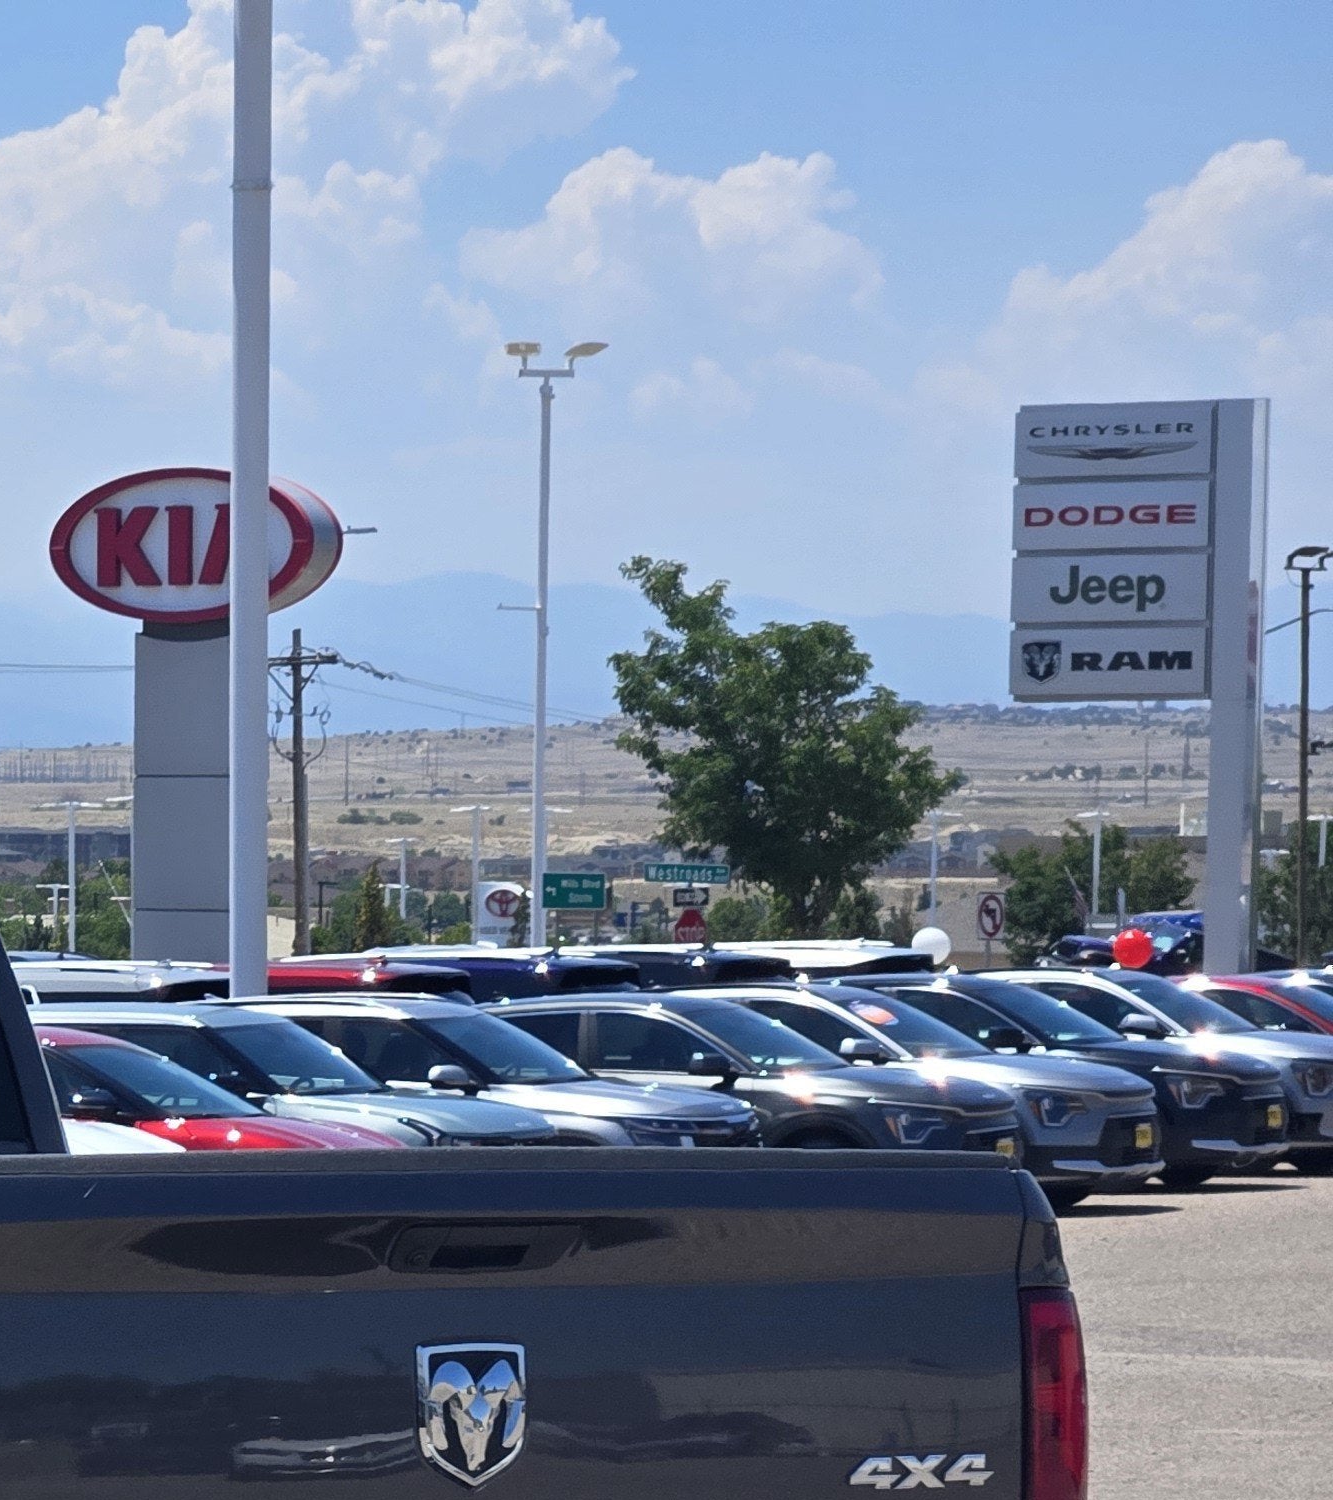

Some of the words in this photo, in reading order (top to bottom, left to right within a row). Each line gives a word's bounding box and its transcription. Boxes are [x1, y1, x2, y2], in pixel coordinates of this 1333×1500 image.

[1028, 422, 1194, 438] CHRYSLER
[1024, 504, 1196, 527] DODGE
[1050, 565, 1165, 612] Jeep
[1071, 650, 1193, 671] RAM
[648, 866, 713, 881] Westroads
